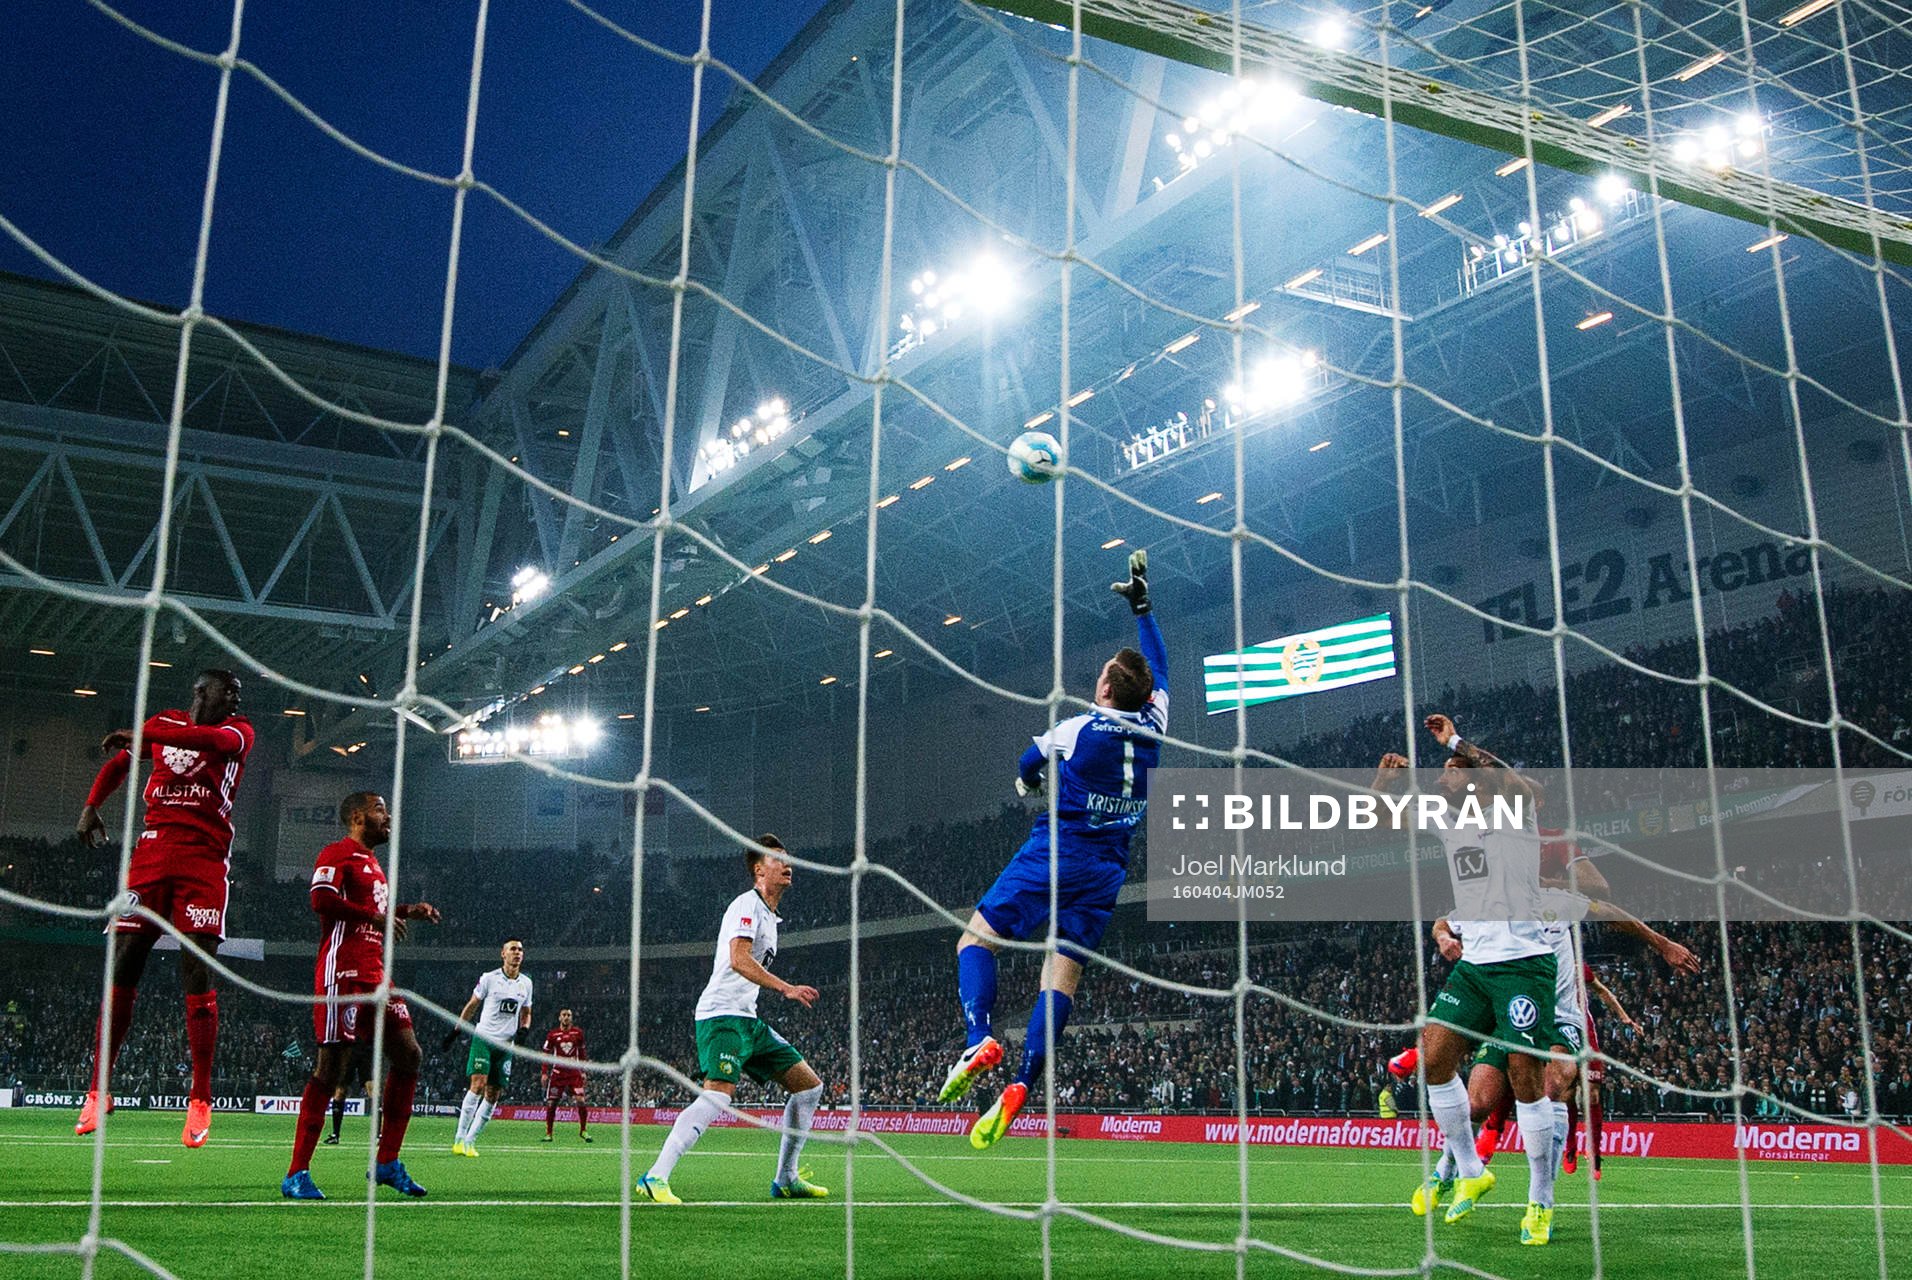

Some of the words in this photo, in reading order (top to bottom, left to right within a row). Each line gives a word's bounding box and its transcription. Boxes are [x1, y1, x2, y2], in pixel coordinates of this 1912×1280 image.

[185, 904, 220, 921] Sports
[193, 912, 219, 927] gym
[25, 1092, 72, 1105] GRÖNE
[75, 1094, 141, 1107] JREN
[1101, 1116, 1162, 1134] Moderna
[1734, 1125, 1860, 1151] Moderna
